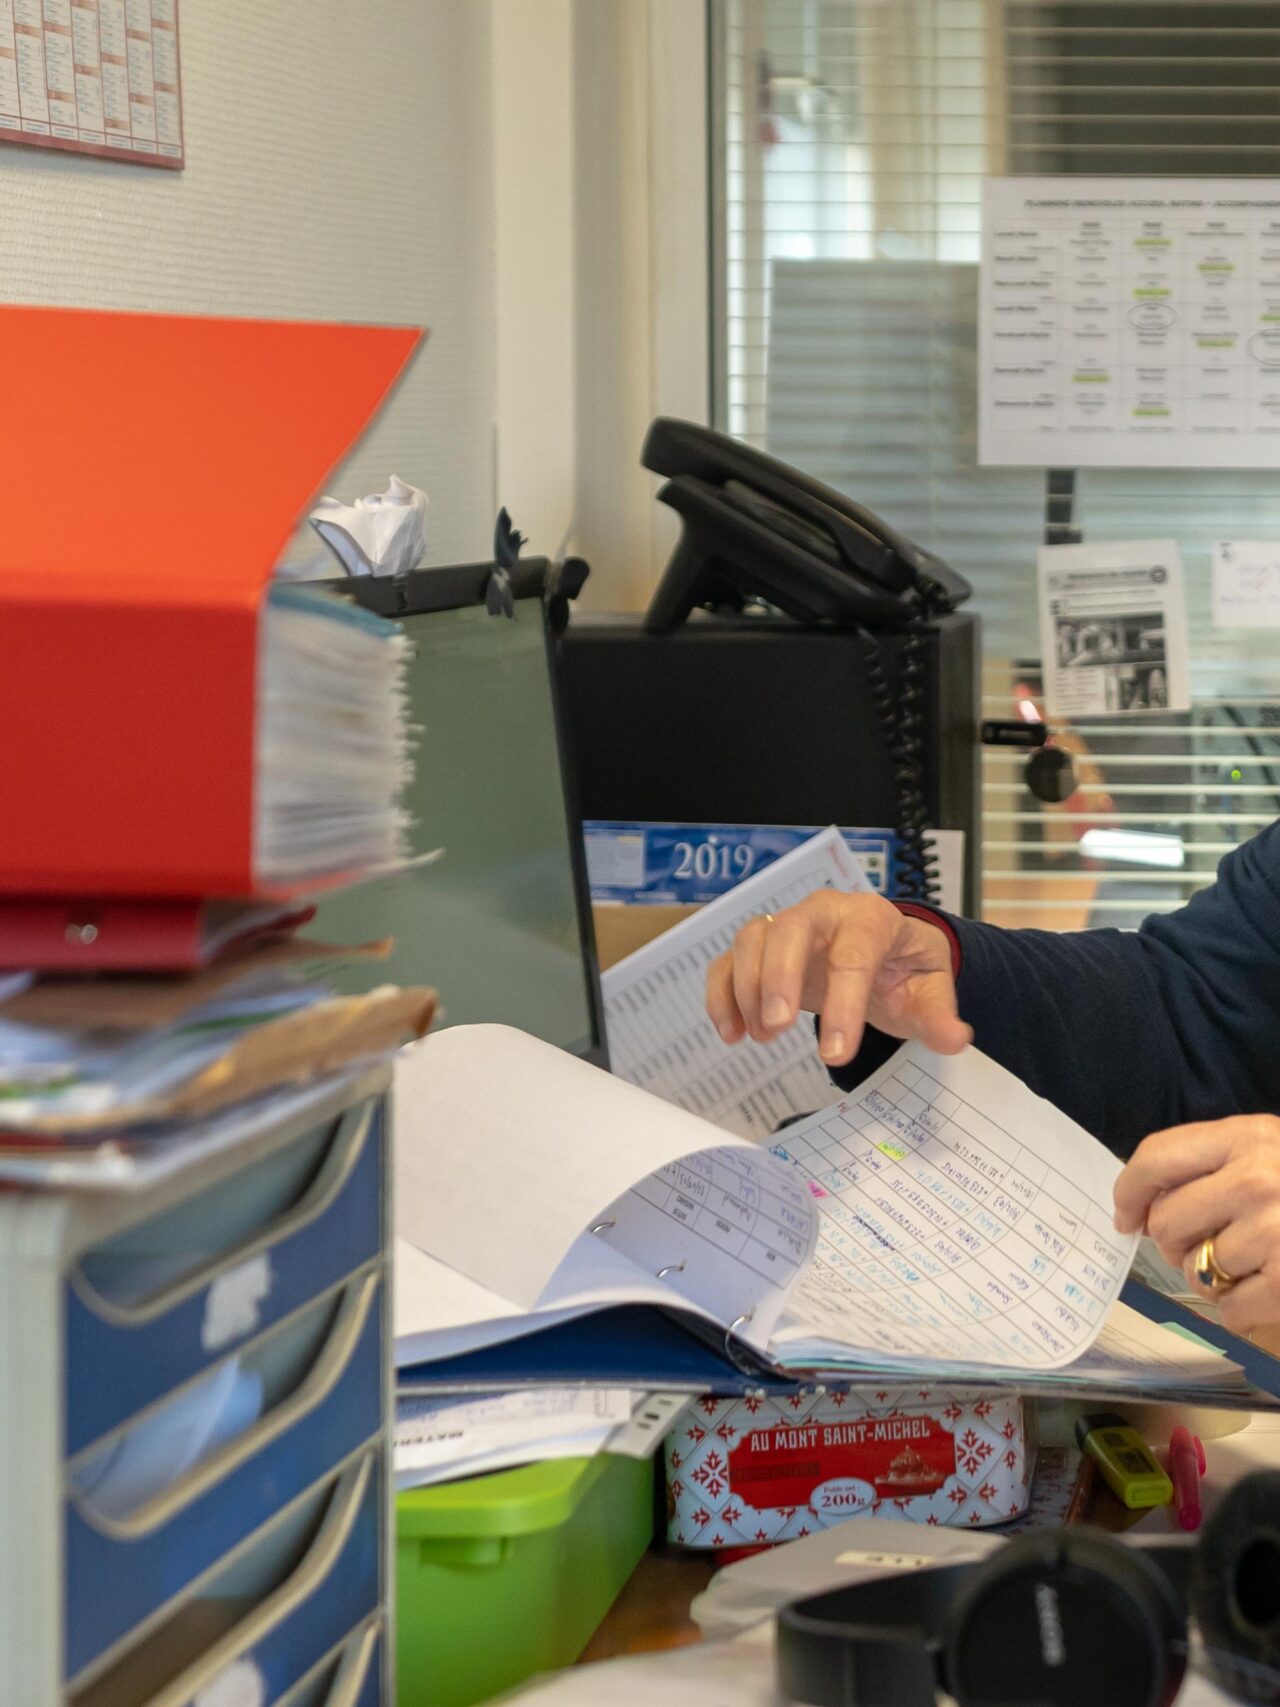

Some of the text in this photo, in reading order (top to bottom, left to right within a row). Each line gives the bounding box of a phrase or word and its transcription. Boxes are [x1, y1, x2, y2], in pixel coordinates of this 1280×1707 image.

[673, 842, 755, 879] 2019
[751, 1420, 930, 1452] AU MONT SAINT-MICHEL
